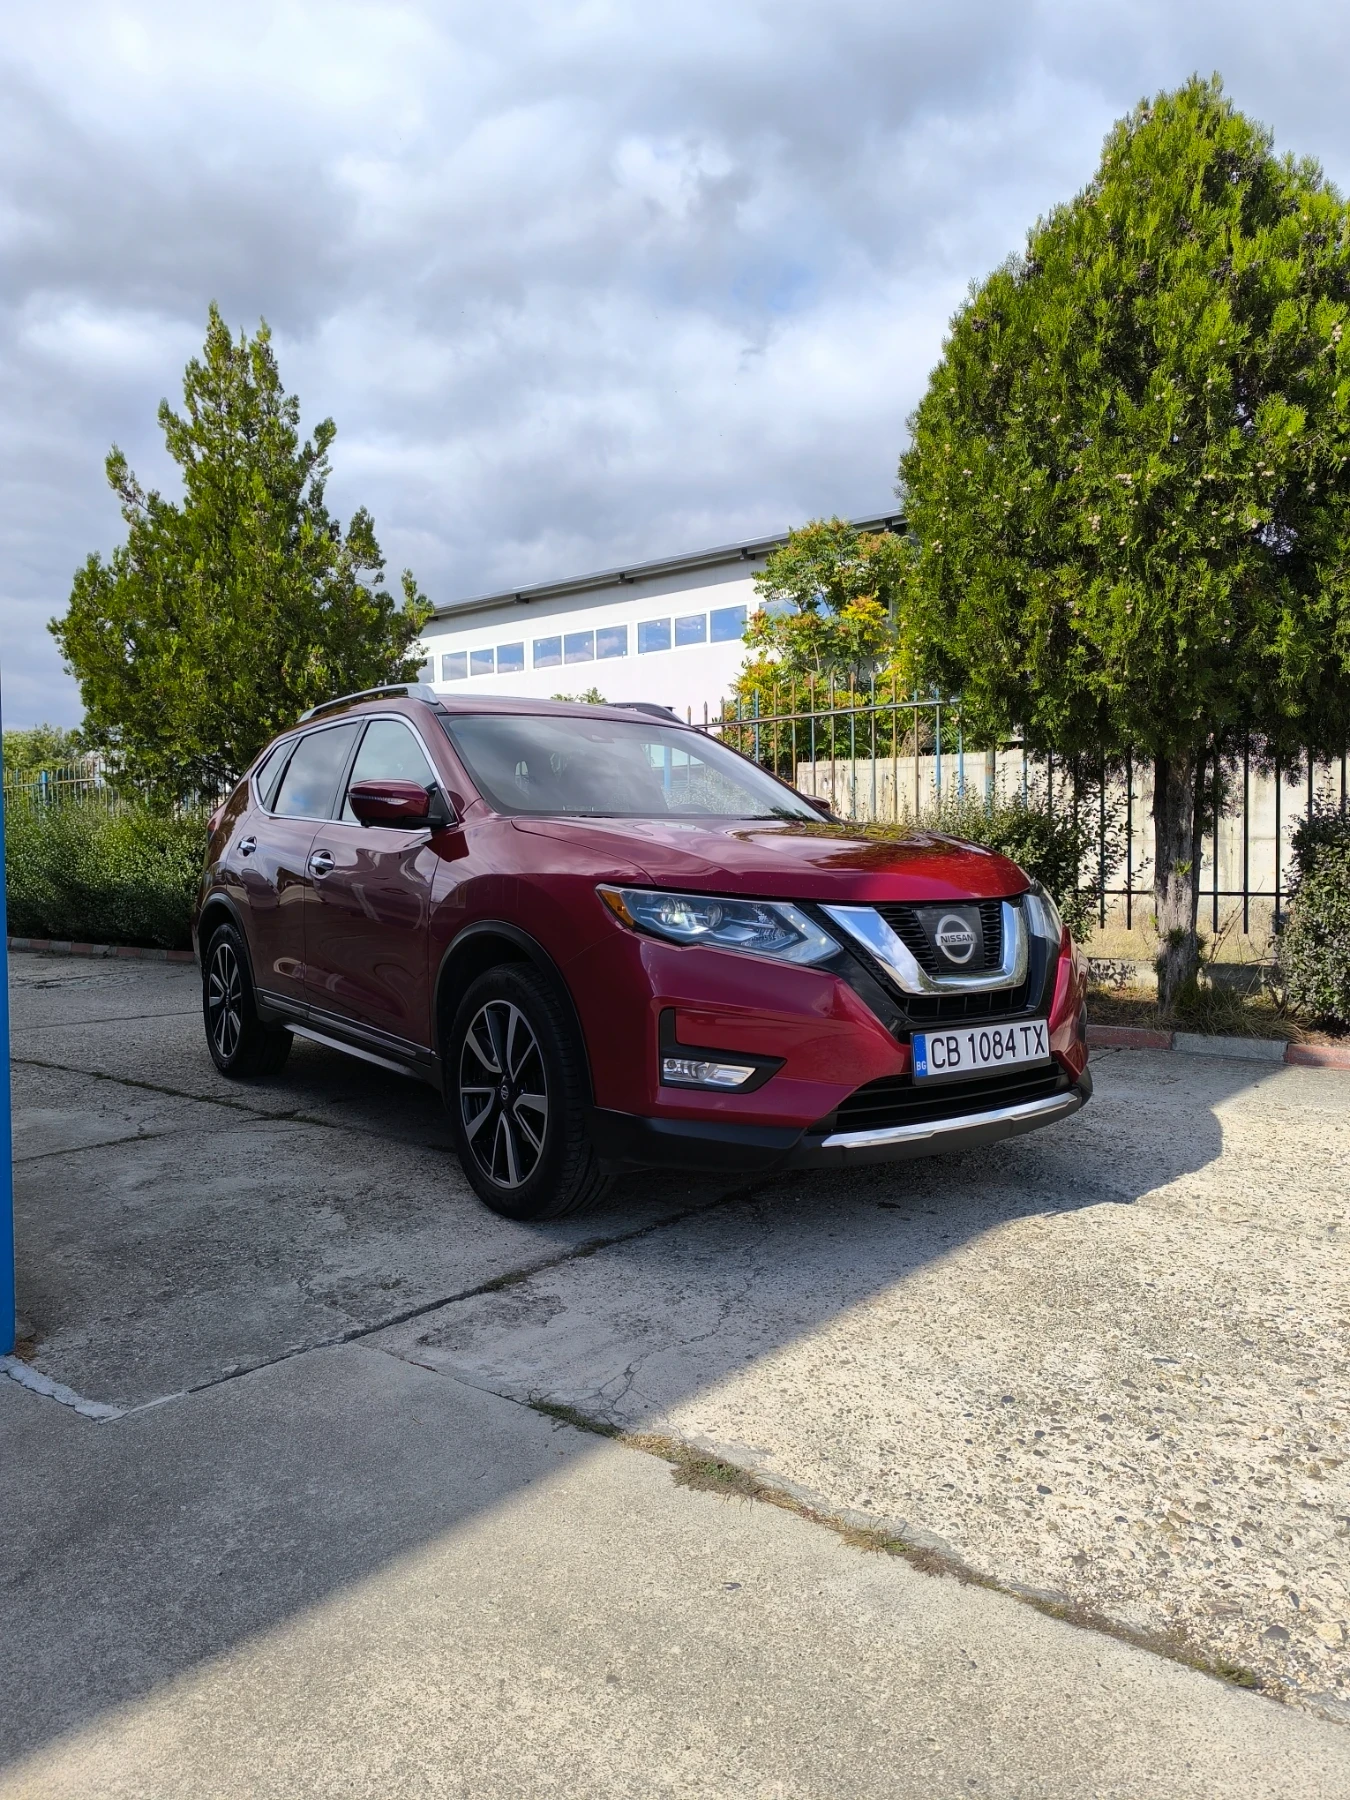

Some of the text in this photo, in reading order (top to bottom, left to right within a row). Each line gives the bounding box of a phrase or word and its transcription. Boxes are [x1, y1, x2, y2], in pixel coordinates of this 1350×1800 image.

[940, 934, 974, 943] NISSAN
[930, 1024, 1046, 1069] CB 1084 TX
[916, 1060, 927, 1071] BG
